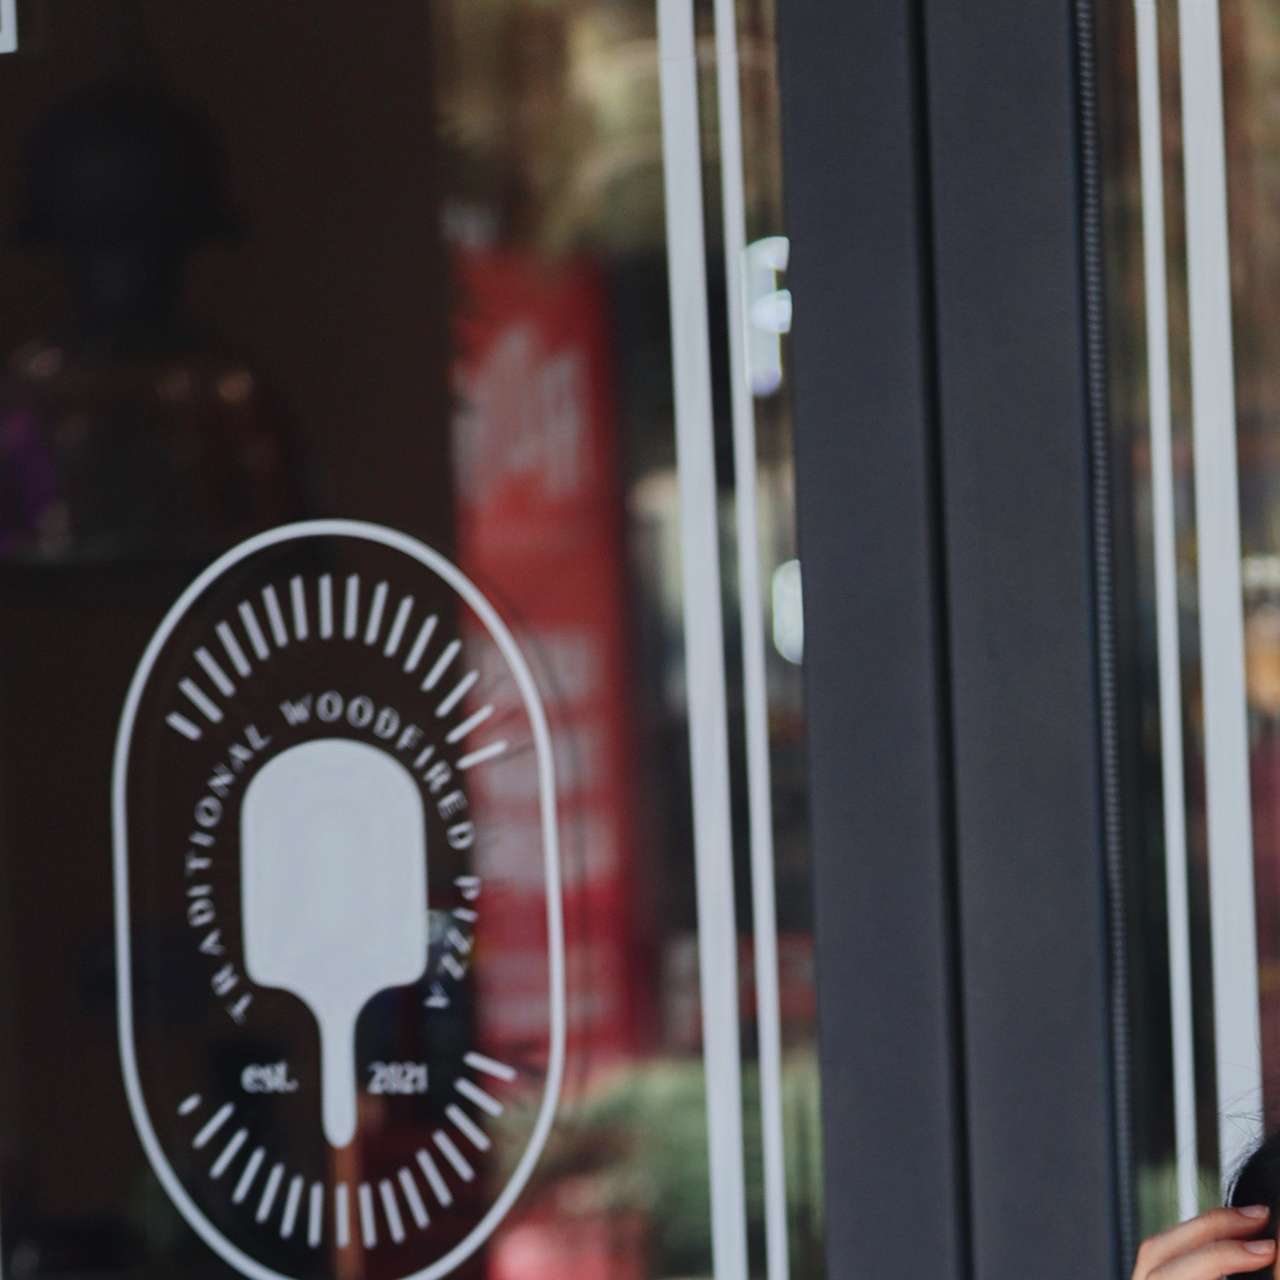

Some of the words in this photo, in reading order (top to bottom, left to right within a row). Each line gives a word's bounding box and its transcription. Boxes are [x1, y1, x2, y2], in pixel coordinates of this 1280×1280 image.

[184, 724, 271, 1024] TRADITIONAL
[279, 690, 476, 850] WOODFIRED
[424, 875, 482, 1009] PIZZA
[367, 1061, 428, 1094] 2021
